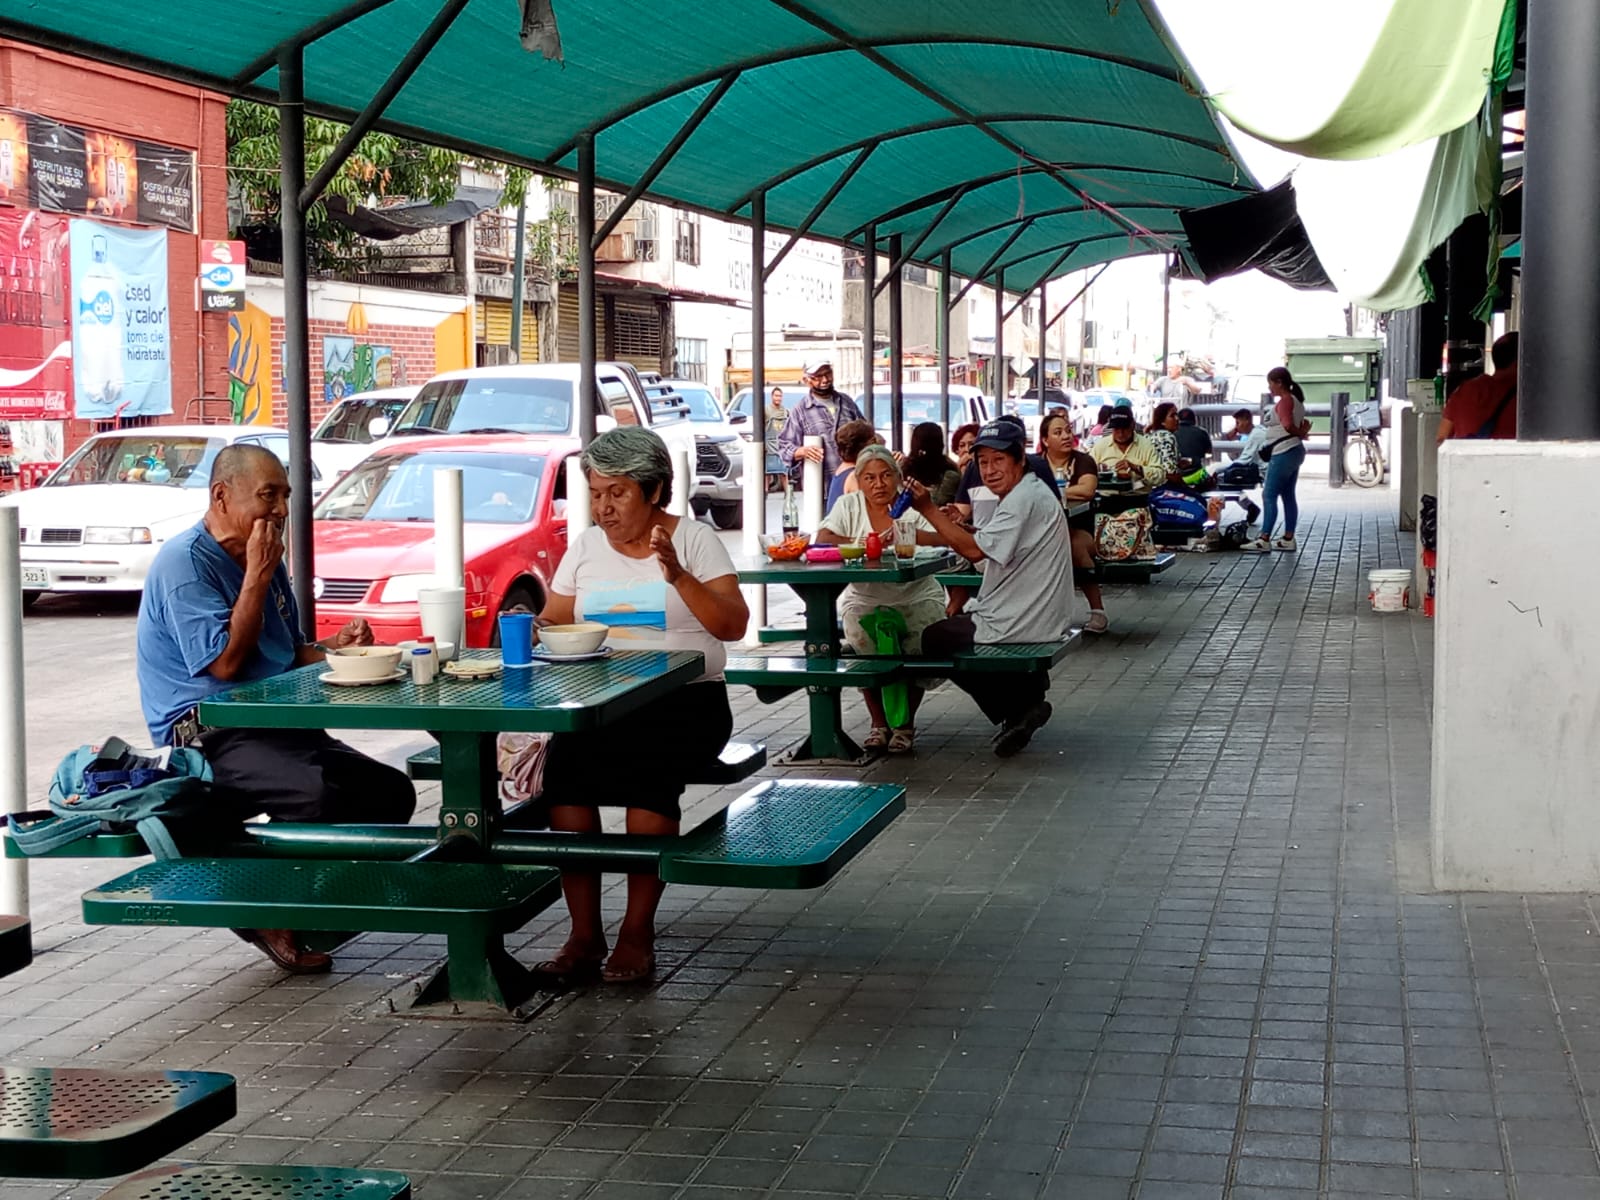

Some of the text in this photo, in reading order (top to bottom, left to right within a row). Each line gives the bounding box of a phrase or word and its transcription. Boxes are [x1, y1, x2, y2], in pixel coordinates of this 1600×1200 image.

[32, 158, 84, 178] DISFRUTA DE SU
[143, 182, 191, 198] DISFRUTA DE SU
[210, 269, 231, 281] ciel
[125, 283, 151, 301] ¿sed
[125, 309, 133, 327] y
[127, 331, 148, 343] toma
